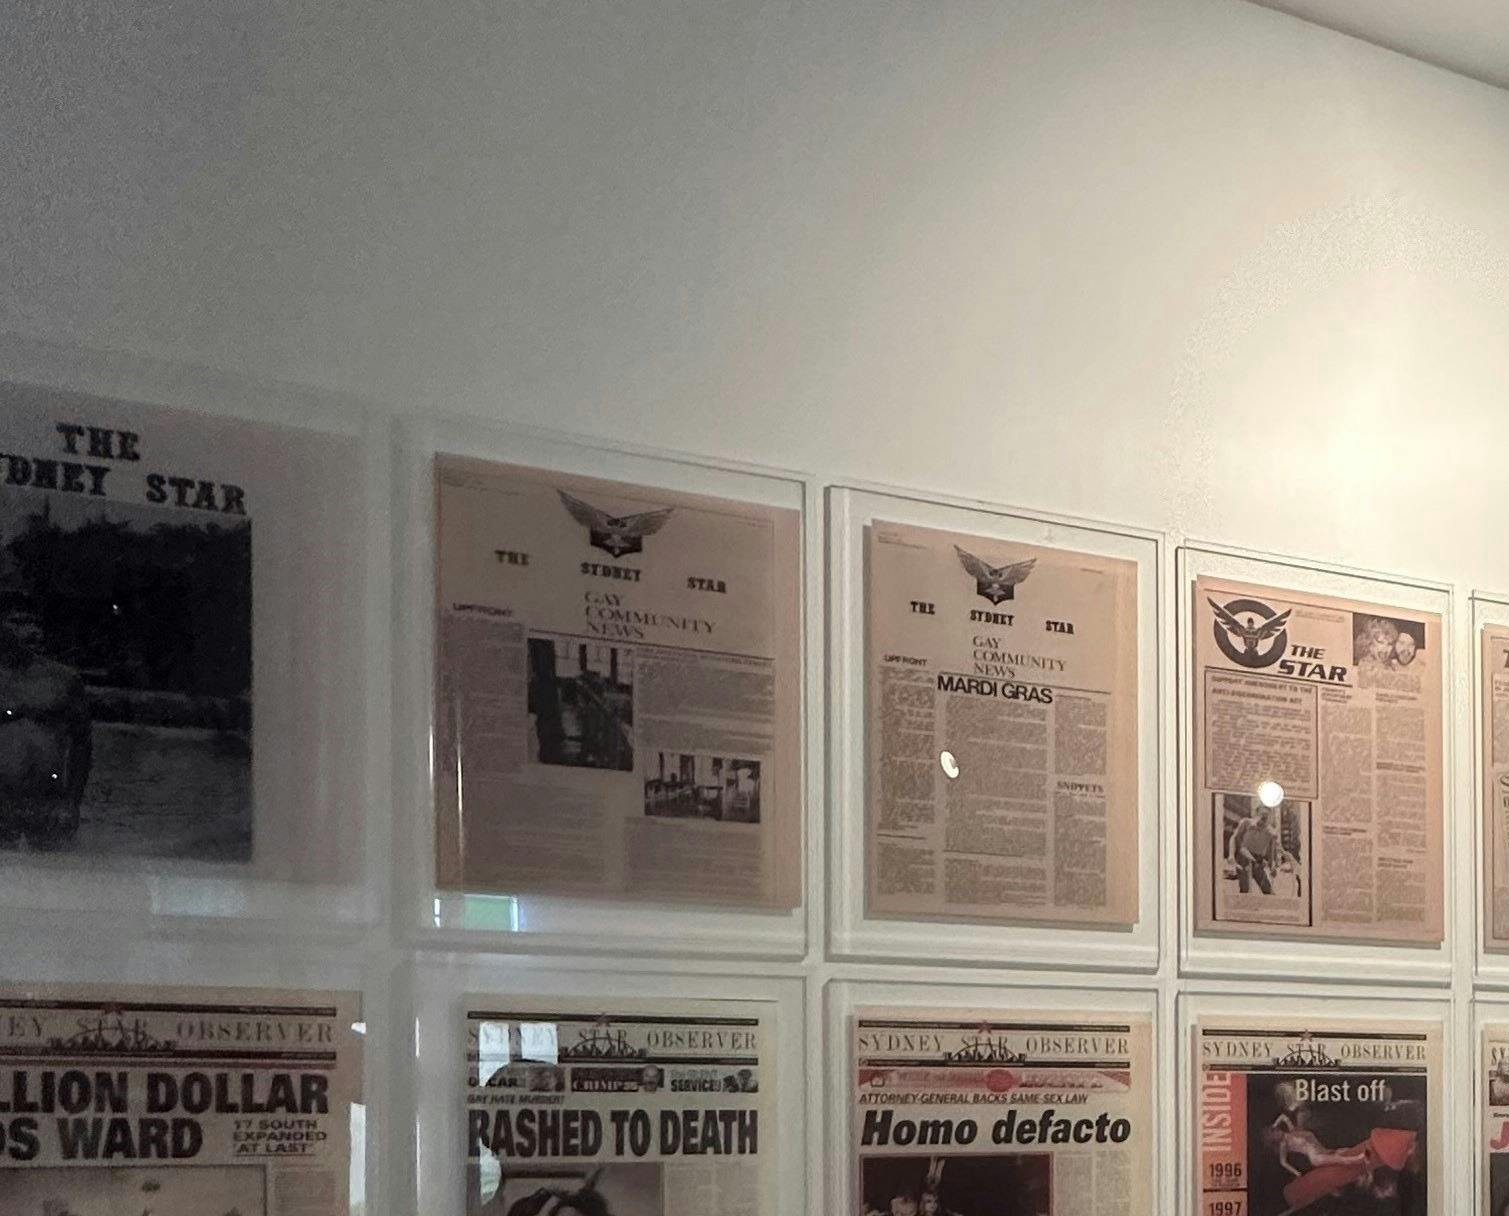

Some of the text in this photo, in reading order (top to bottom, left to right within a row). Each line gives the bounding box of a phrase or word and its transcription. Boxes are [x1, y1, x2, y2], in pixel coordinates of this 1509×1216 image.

[56, 422, 140, 461] THE
[0, 453, 246, 515] DNEY STAR
[495, 550, 726, 593] THE SYDNEY STAR
[584, 591, 625, 607] GAY
[584, 606, 716, 635] COMMUNITY
[910, 601, 1074, 635] THE SYDNEY STAR
[587, 621, 645, 639] NEWS
[973, 635, 1001, 649] GAY
[1290, 644, 1326, 660] THE
[884, 654, 928, 667] UPFRONT
[973, 649, 1067, 672] COMMUNITY
[1277, 658, 1348, 682] STAR
[974, 664, 1016, 679] NEWS
[937, 674, 1053, 704] MARDI GRAS
[176, 1021, 333, 1043] OBSERVER
[647, 1029, 757, 1049] OBSERVER
[859, 1035, 1129, 1055] SYDNEY STAR OBSERVER
[1203, 1040, 1426, 1060] SYDNEY STAR OBSERVER
[147, 1071, 329, 1115] DOLLAR
[973, 1093, 1088, 1105] BACKS SAME LAW
[1296, 1079, 1385, 1102] Blast off
[1202, 1073, 1231, 1152] INSIDE
[259, 1119, 318, 1130] SOUTH
[467, 1108, 759, 1157] BASHED TO DEATH
[861, 1109, 1131, 1146] Homo defacto
[56, 1117, 204, 1160] WARD
[233, 1130, 327, 1142] EXPANDED
[236, 1142, 308, 1153] AT LAST
[1209, 1164, 1242, 1178] 1996
[1209, 1202, 1242, 1216] 1997
